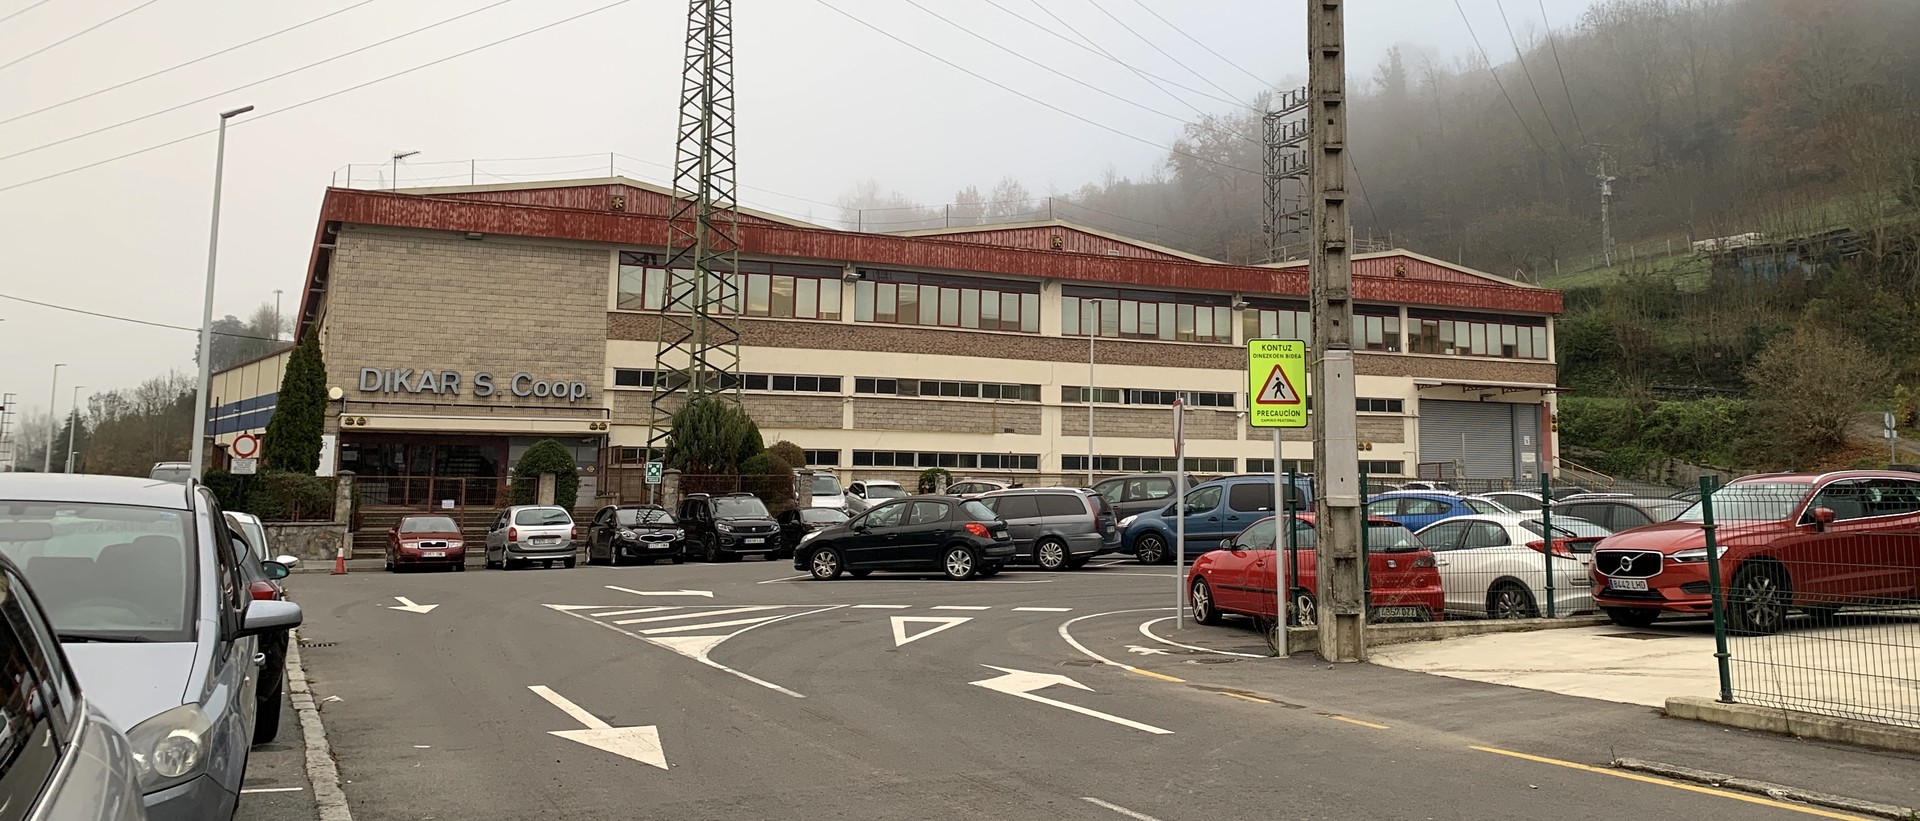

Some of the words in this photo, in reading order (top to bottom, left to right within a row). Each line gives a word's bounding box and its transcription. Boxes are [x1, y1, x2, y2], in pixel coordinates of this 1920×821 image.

[359, 367, 461, 395] DIKAR
[473, 371, 503, 397] S.
[510, 372, 593, 402] Coop.
[1613, 580, 1631, 589] 8442
